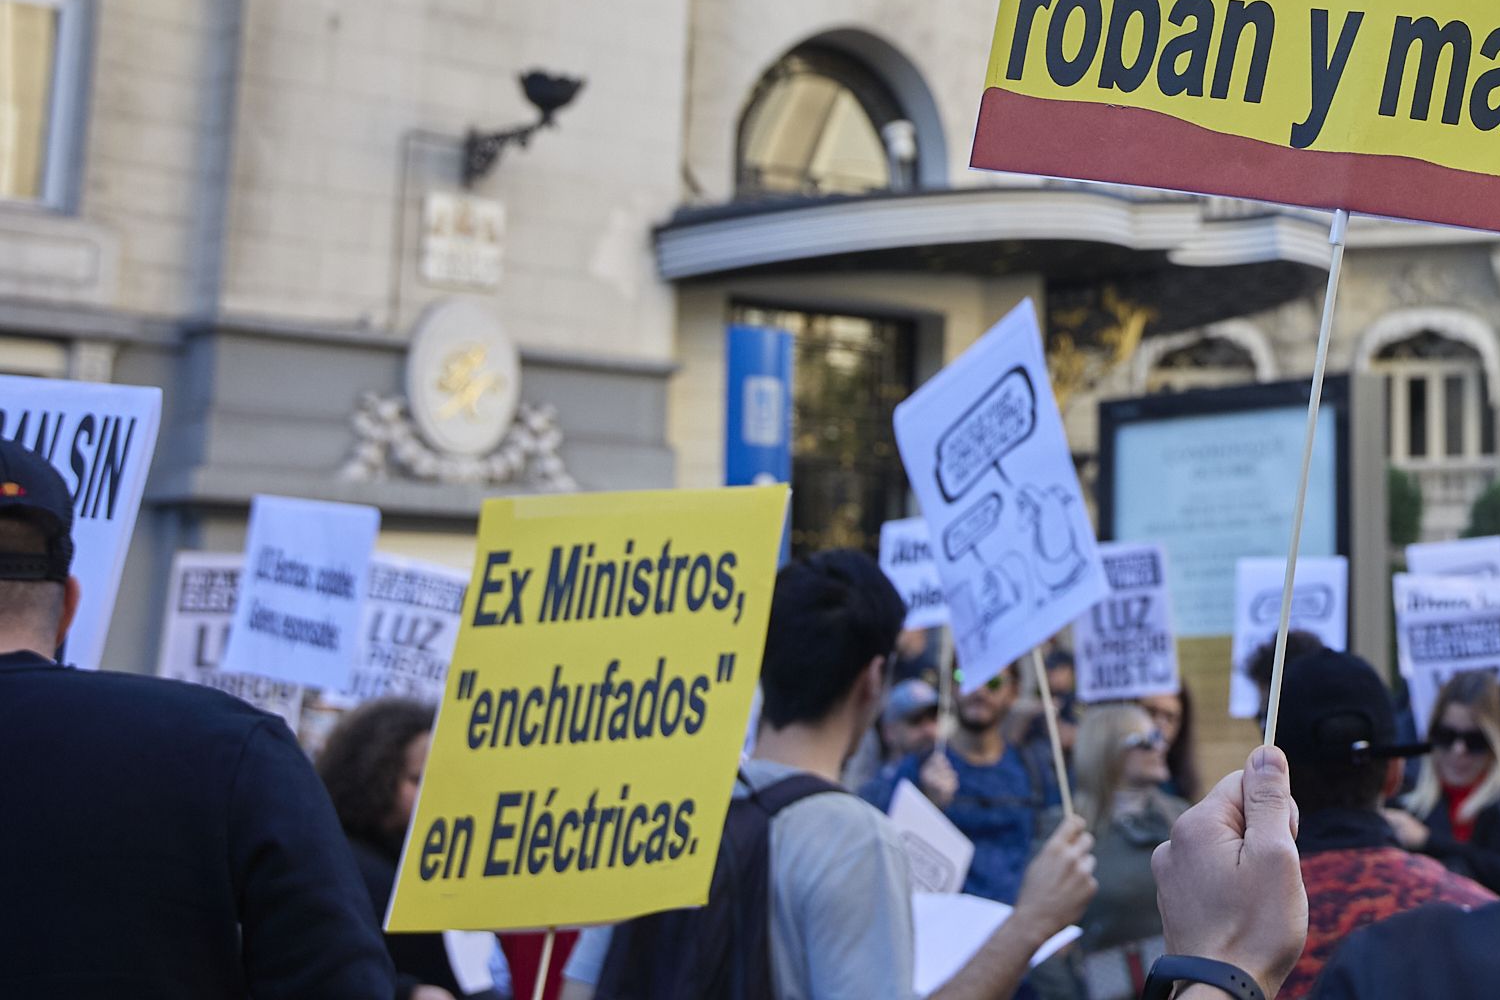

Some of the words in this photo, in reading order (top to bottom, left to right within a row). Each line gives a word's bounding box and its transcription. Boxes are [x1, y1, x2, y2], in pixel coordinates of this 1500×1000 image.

[1289, 7, 1366, 151] y
[70, 411, 139, 521] SIN
[366, 609, 446, 652] LUZ
[470, 549, 533, 629] Ex
[537, 537, 747, 625] Ministros,
[456, 651, 737, 751] "enchufados"
[417, 812, 477, 884] en
[482, 782, 698, 880] Eléctricas.
